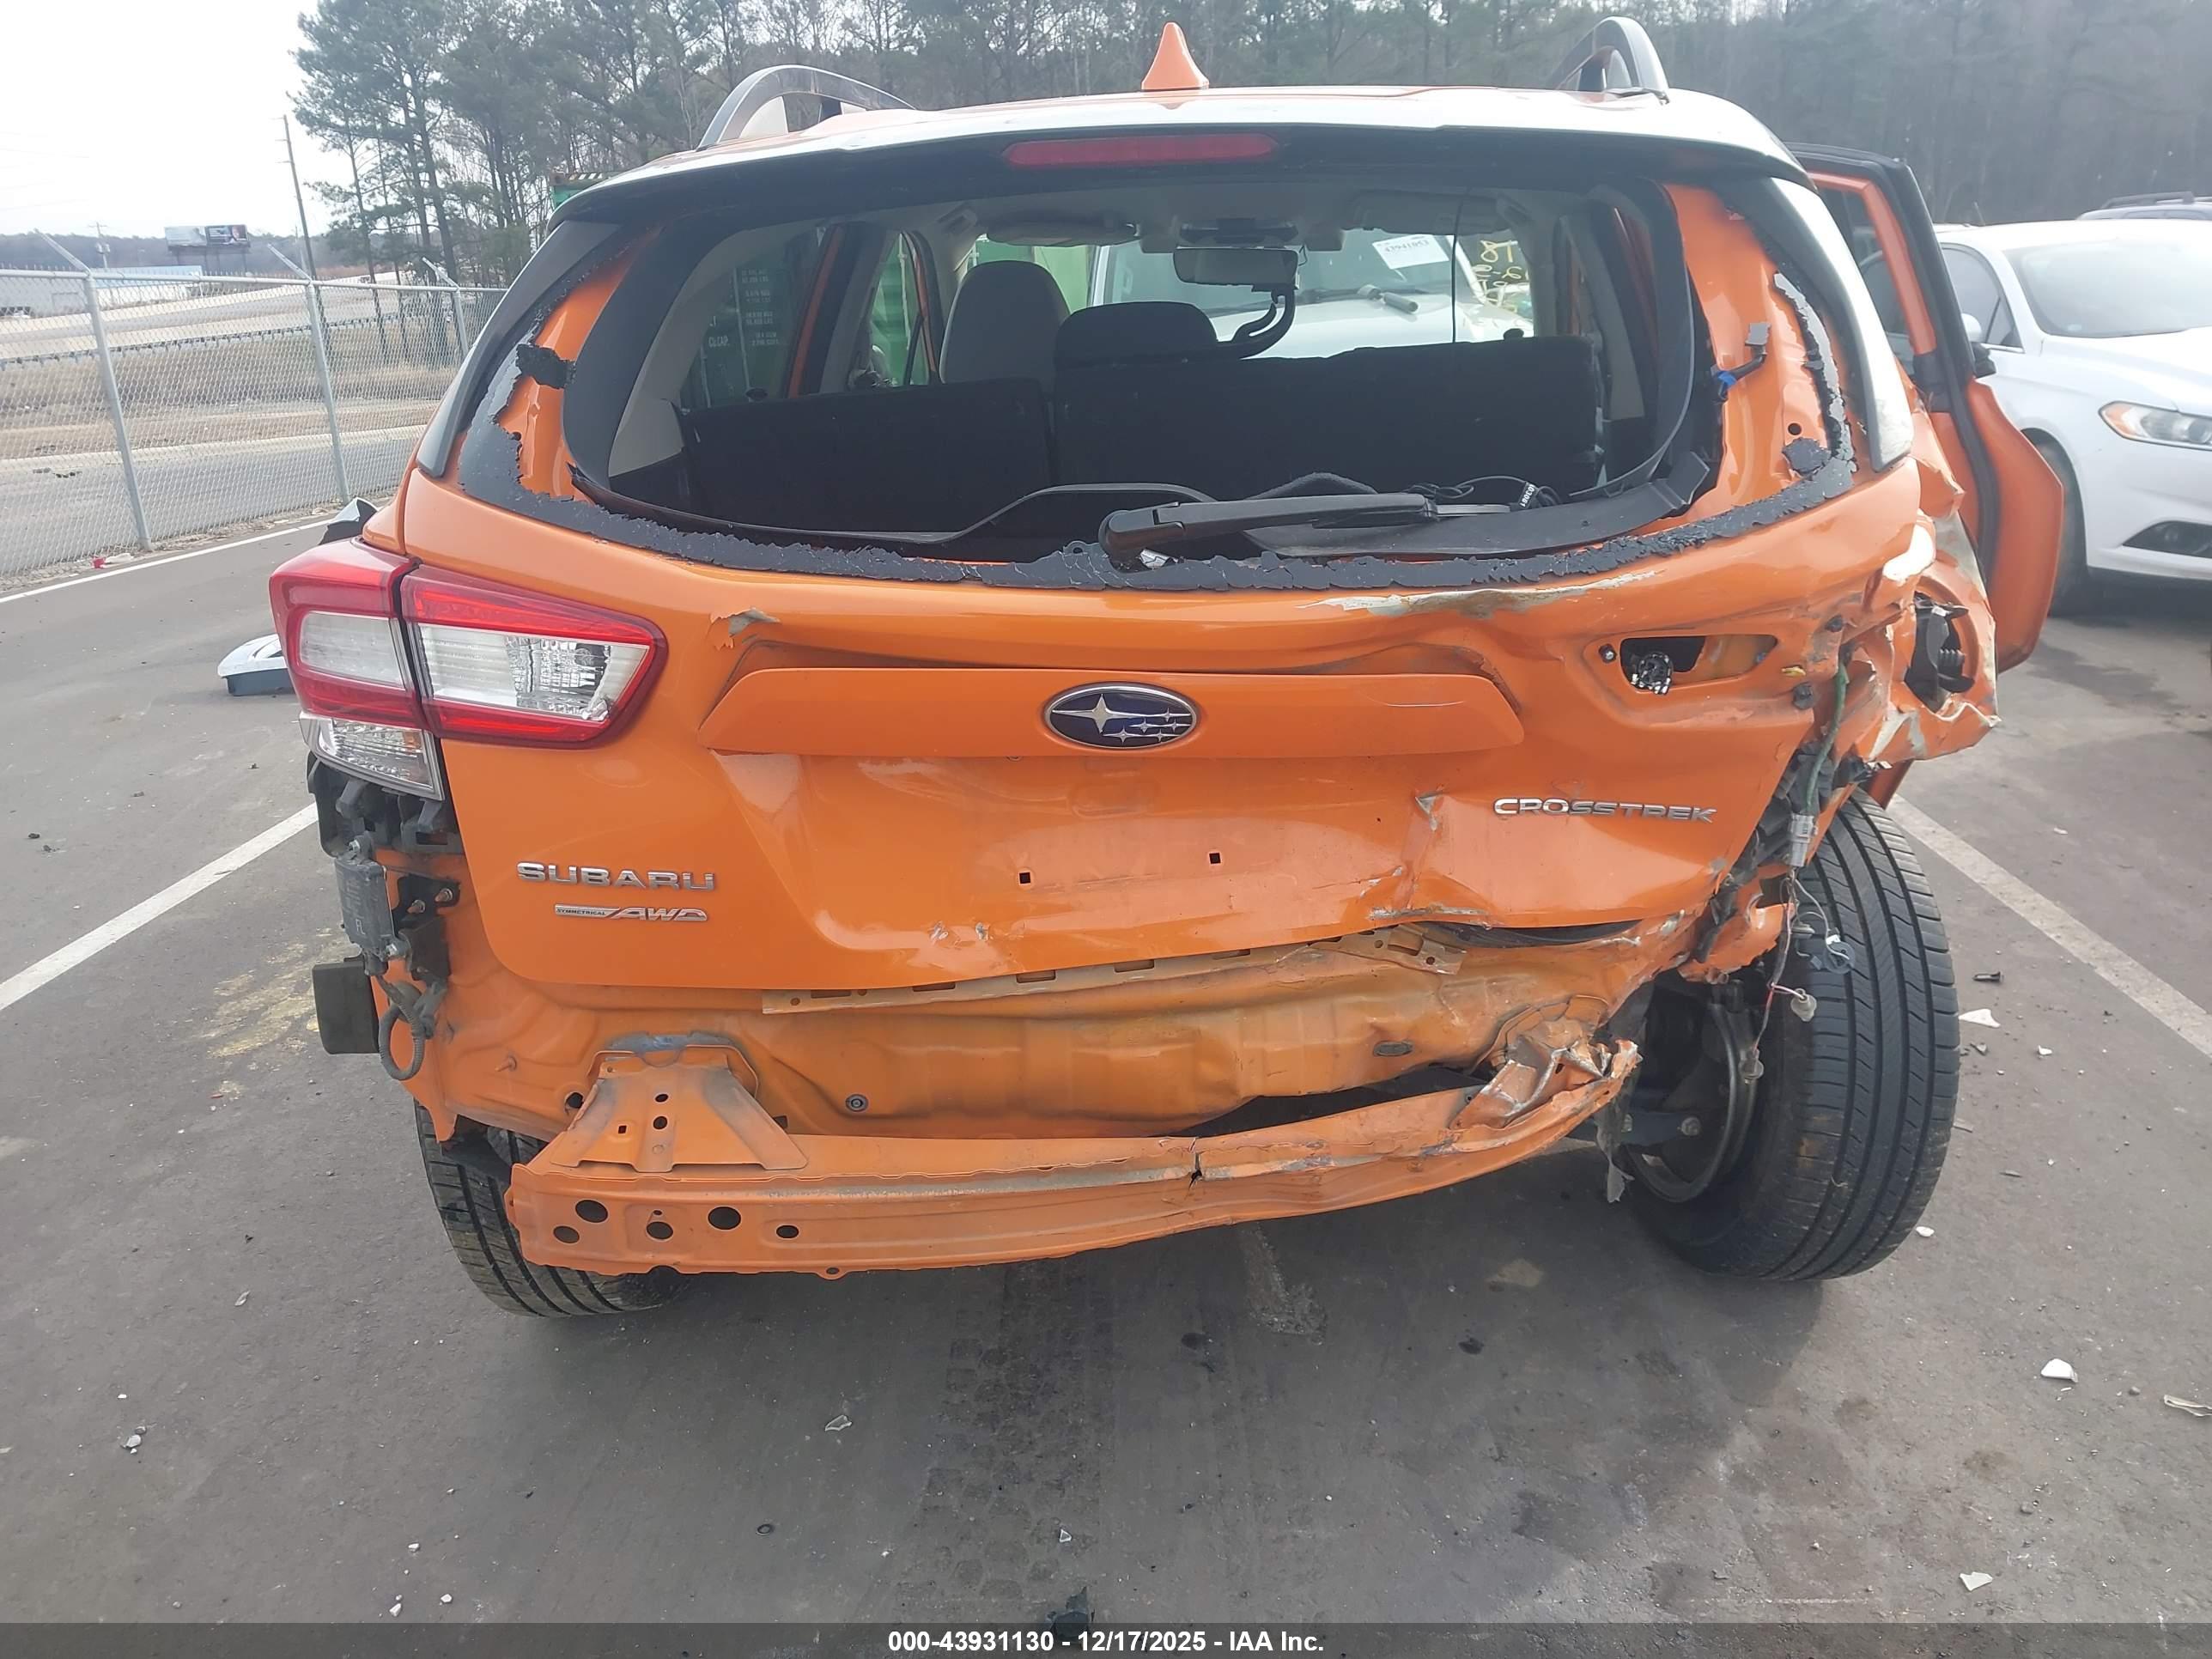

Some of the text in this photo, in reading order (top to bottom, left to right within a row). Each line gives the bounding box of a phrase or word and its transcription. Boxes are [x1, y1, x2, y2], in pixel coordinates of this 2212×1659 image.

[1492, 797, 1717, 823] CROSSTREK
[517, 861, 715, 891] SUBARU
[611, 907, 708, 921] AWD
